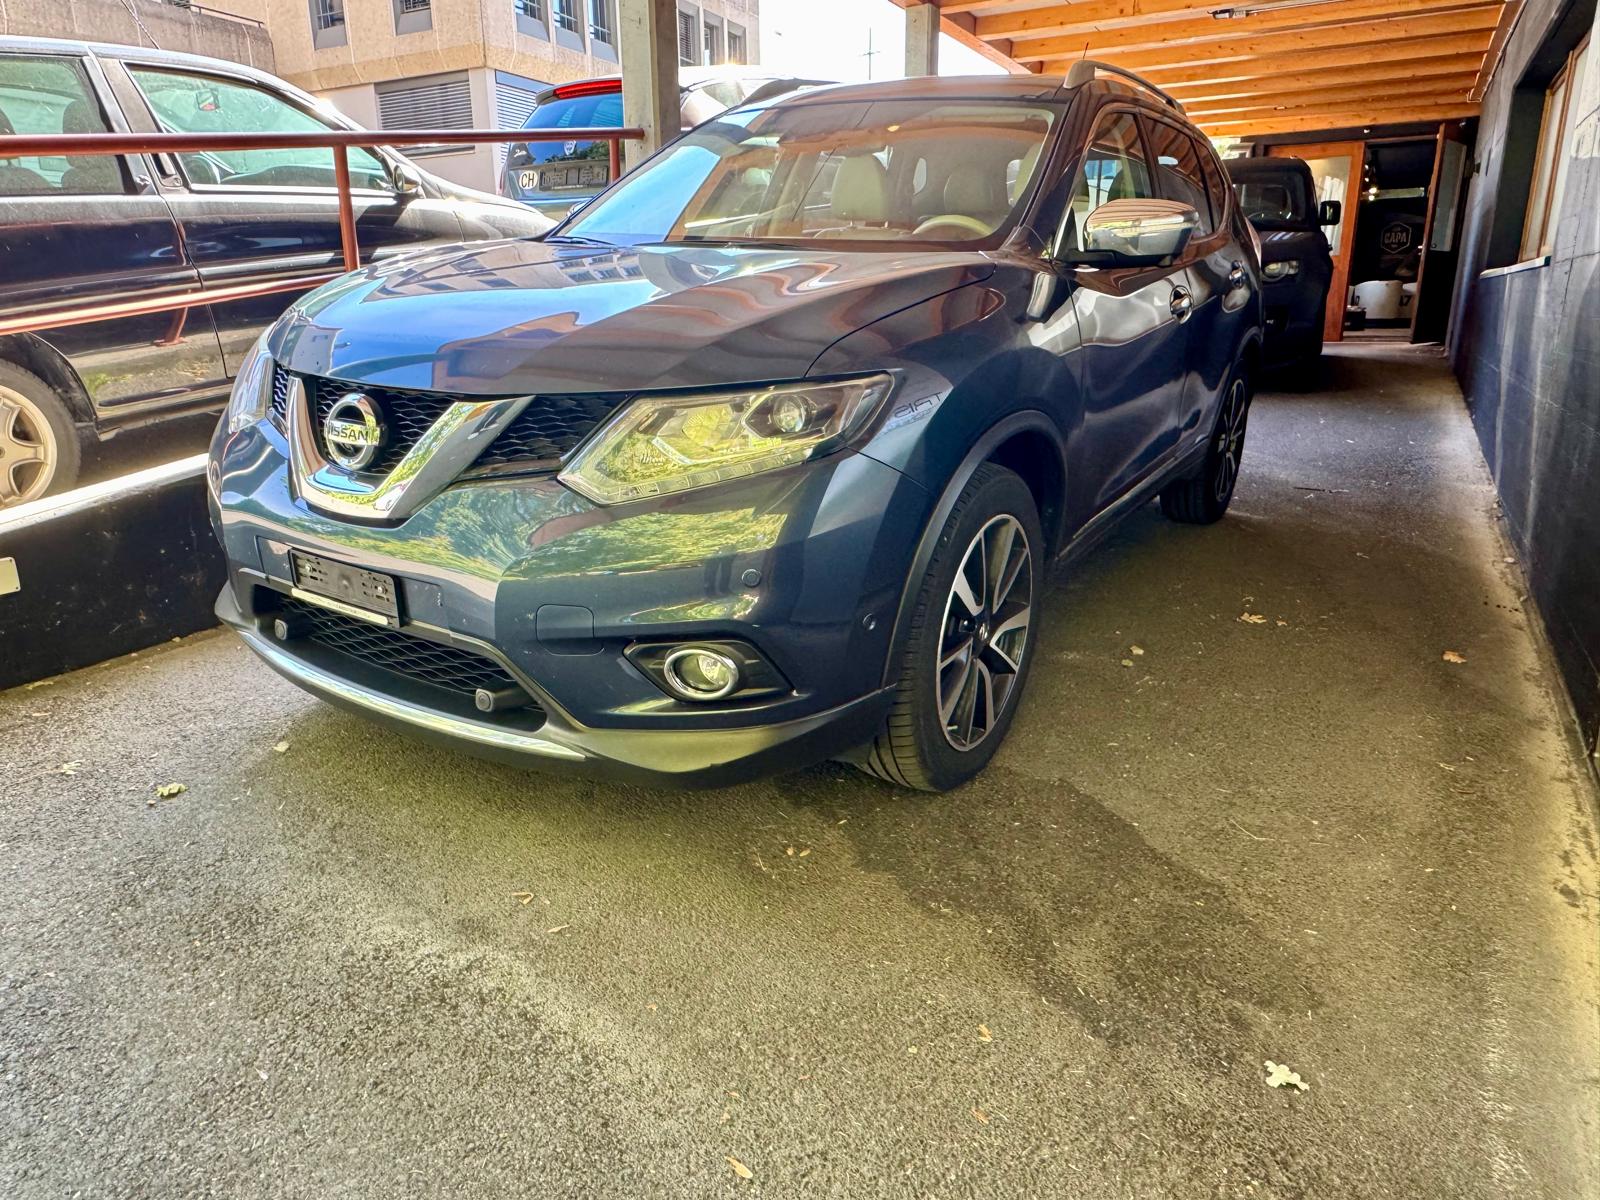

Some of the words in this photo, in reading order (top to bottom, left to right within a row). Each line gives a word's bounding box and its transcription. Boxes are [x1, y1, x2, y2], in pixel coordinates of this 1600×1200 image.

[521, 172, 535, 188] CH
[1384, 231, 1407, 244] CAPA
[326, 422, 369, 443] NISSAN
